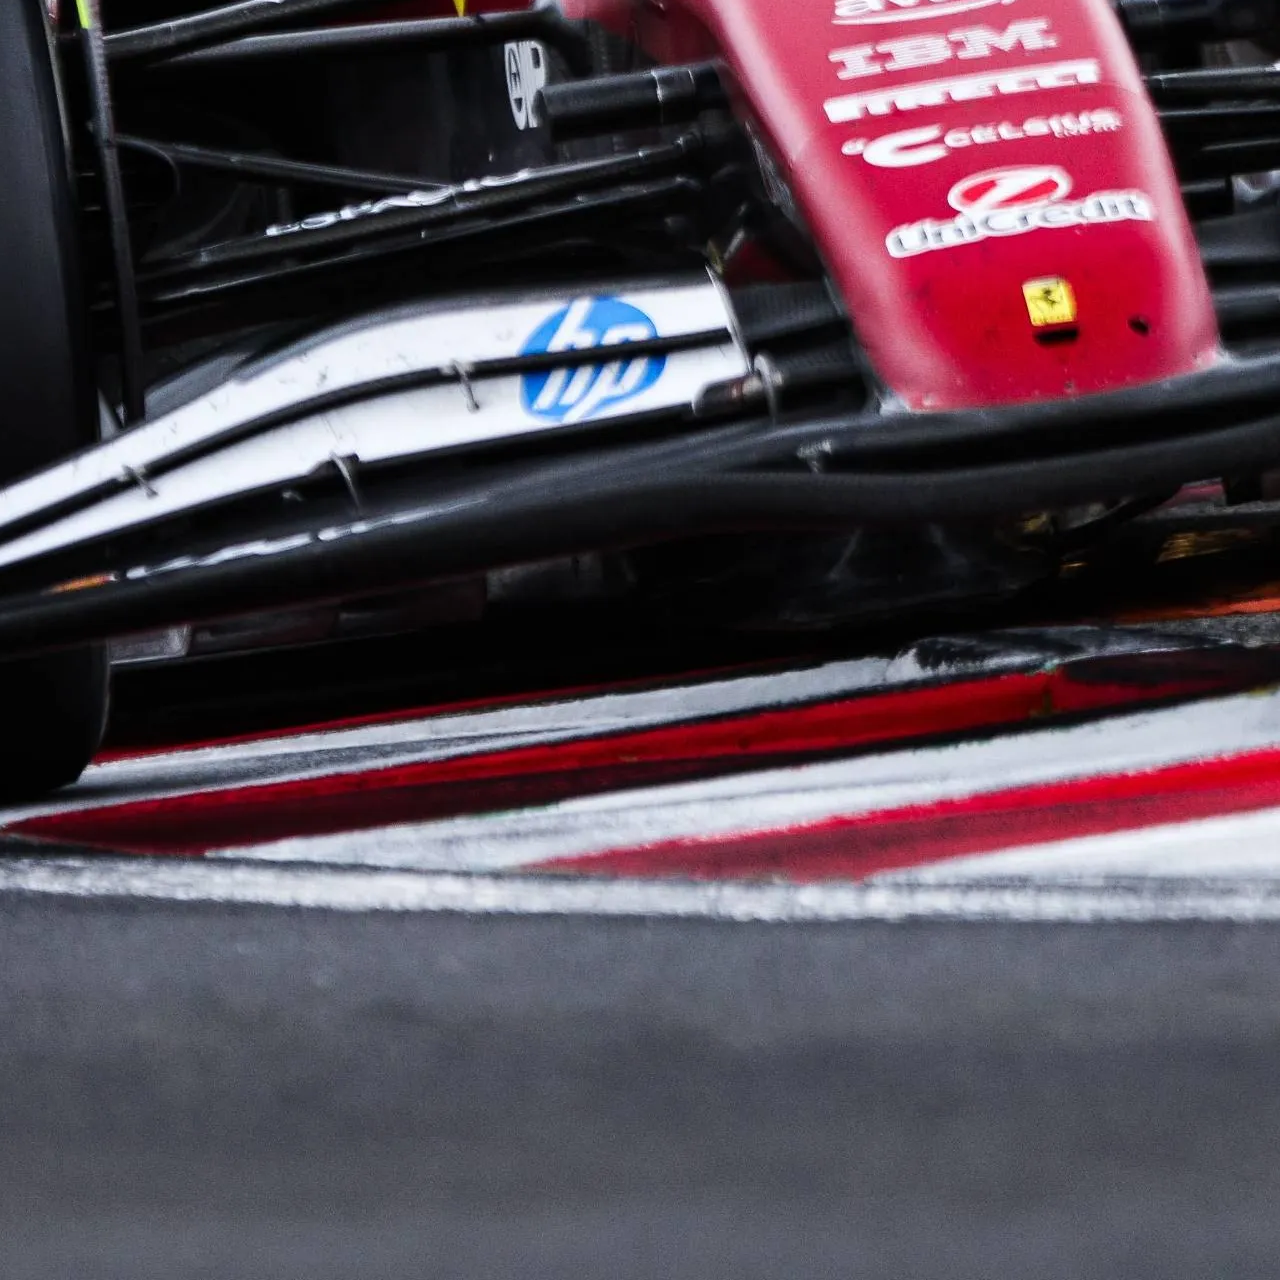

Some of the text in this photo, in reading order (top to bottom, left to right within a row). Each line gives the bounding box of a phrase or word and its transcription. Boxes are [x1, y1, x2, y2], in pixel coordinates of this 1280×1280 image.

[827, 16, 1058, 81] IBM
[823, 57, 1102, 124] PIRELLI
[886, 189, 1153, 258] UniCredit
